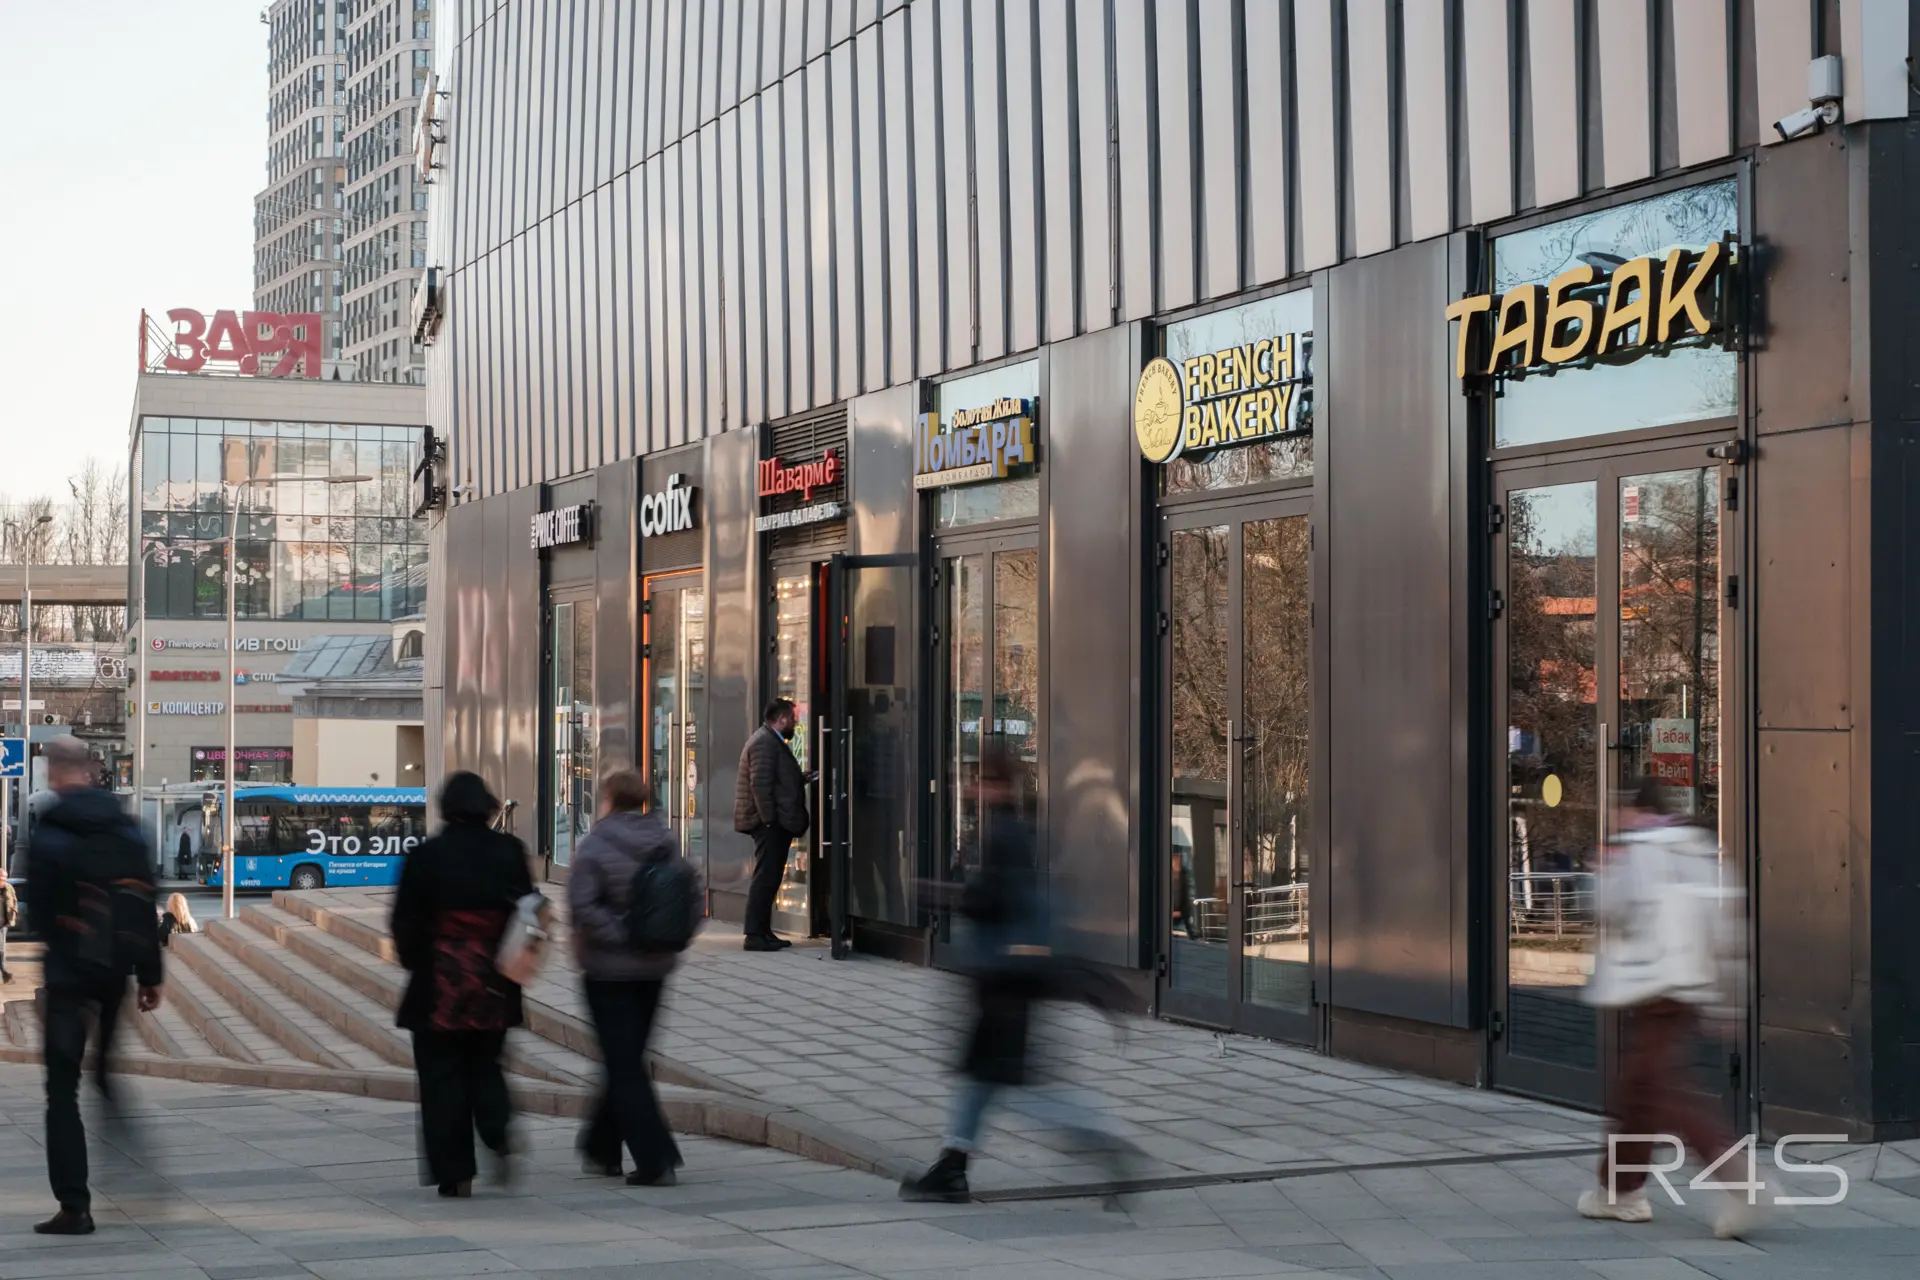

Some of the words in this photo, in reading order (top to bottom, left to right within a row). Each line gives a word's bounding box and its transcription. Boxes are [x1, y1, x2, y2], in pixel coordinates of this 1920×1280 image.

[1445, 242, 1719, 379] ТАБАК
[163, 308, 321, 378] ЗАРЯ
[1185, 333, 1295, 402] FRENCH
[1185, 384, 1292, 448] BAKERY
[640, 473, 693, 538] cofix
[555, 504, 580, 545] COFFEE
[265, 638, 301, 651] ГОШ
[162, 701, 224, 716] КОПИЦЕНТР
[1656, 727, 1691, 745] Табак
[207, 751, 268, 760] ЦВЕОЧНАЯ
[1657, 760, 1689, 779] Вейп
[305, 828, 361, 855] Это
